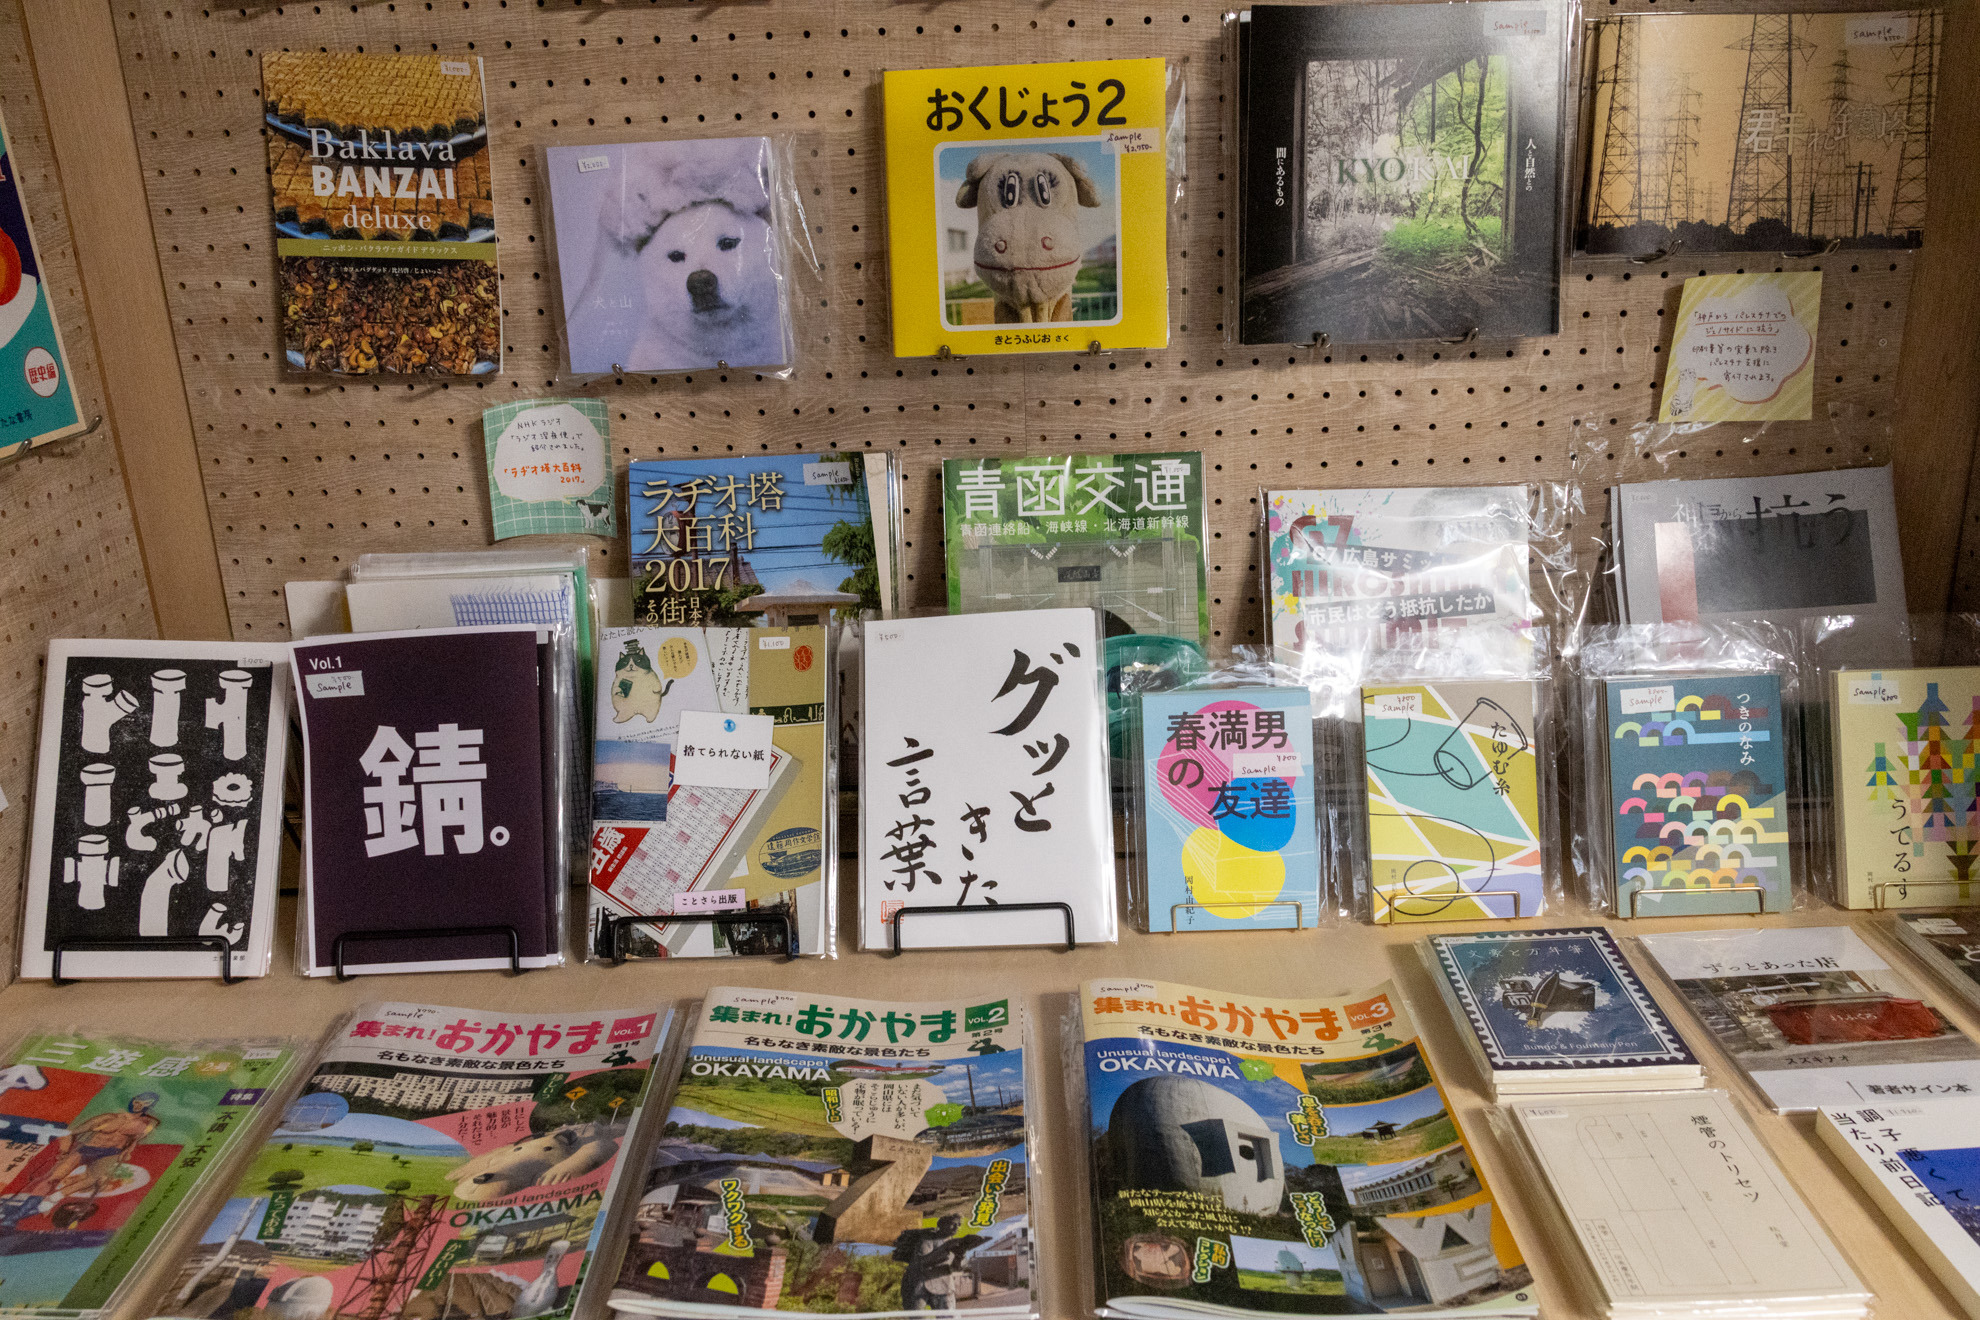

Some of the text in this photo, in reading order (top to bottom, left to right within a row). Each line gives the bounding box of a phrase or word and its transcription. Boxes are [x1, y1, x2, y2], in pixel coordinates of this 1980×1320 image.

[926, 78, 1127, 132] おくじょう2
[307, 127, 457, 162] Baklava
[311, 165, 456, 200] BANZAI
[1275, 147, 1287, 207] 間にあるもの
[1337, 153, 1470, 184] KYOKAI
[1524, 138, 1537, 192] 人と自然との
[342, 205, 432, 230] deluxe
[994, 334, 1070, 345] きとうふじお さく
[642, 472, 785, 515] ラヂオ塔
[956, 459, 1188, 519] 青函交通
[642, 512, 758, 554] 大百科
[645, 557, 730, 593] 2017
[660, 597, 688, 625] 街
[1308, 592, 1494, 627] 市民はどう抵抗したか
[308, 656, 343, 670] Vol.1
[988, 642, 1081, 832] グッと
[1167, 710, 1289, 751] 春満男
[1737, 693, 1756, 766] つきのなみ
[683, 744, 765, 761] 捨てられない紙
[1490, 721, 1511, 796] たゆむ糸
[358, 722, 511, 859] 錆。
[1168, 758, 1205, 789] の
[879, 736, 943, 893] 言葉
[1208, 779, 1291, 821] 友達
[1890, 798, 1911, 900] うてるす
[681, 893, 738, 906] ことさら出版
[1703, 956, 1840, 974] ずっとあった店
[744, 1036, 931, 1058] 名もなき素敵な景色たち
[1097, 1049, 1154, 1060] Unusual
[1137, 1025, 1326, 1057] 名もなき素敵な景色たち
[377, 1050, 566, 1071] 名もなき素敵な景色たち
[690, 1062, 832, 1082] OKAYAMA
[693, 1054, 750, 1065] Unusual
[1099, 1056, 1240, 1081] OKAYAMA
[1786, 1055, 1850, 1065] スズキナオ
[1866, 1083, 1973, 1095] 著者サイン本
[1830, 1112, 1946, 1209] 当たり前日記
[450, 1188, 603, 1228] OKAYAMA
[455, 1196, 518, 1210] Unusual
[973, 1161, 1009, 1227] 出会いと発見
[722, 1180, 750, 1248] ワクワクする
